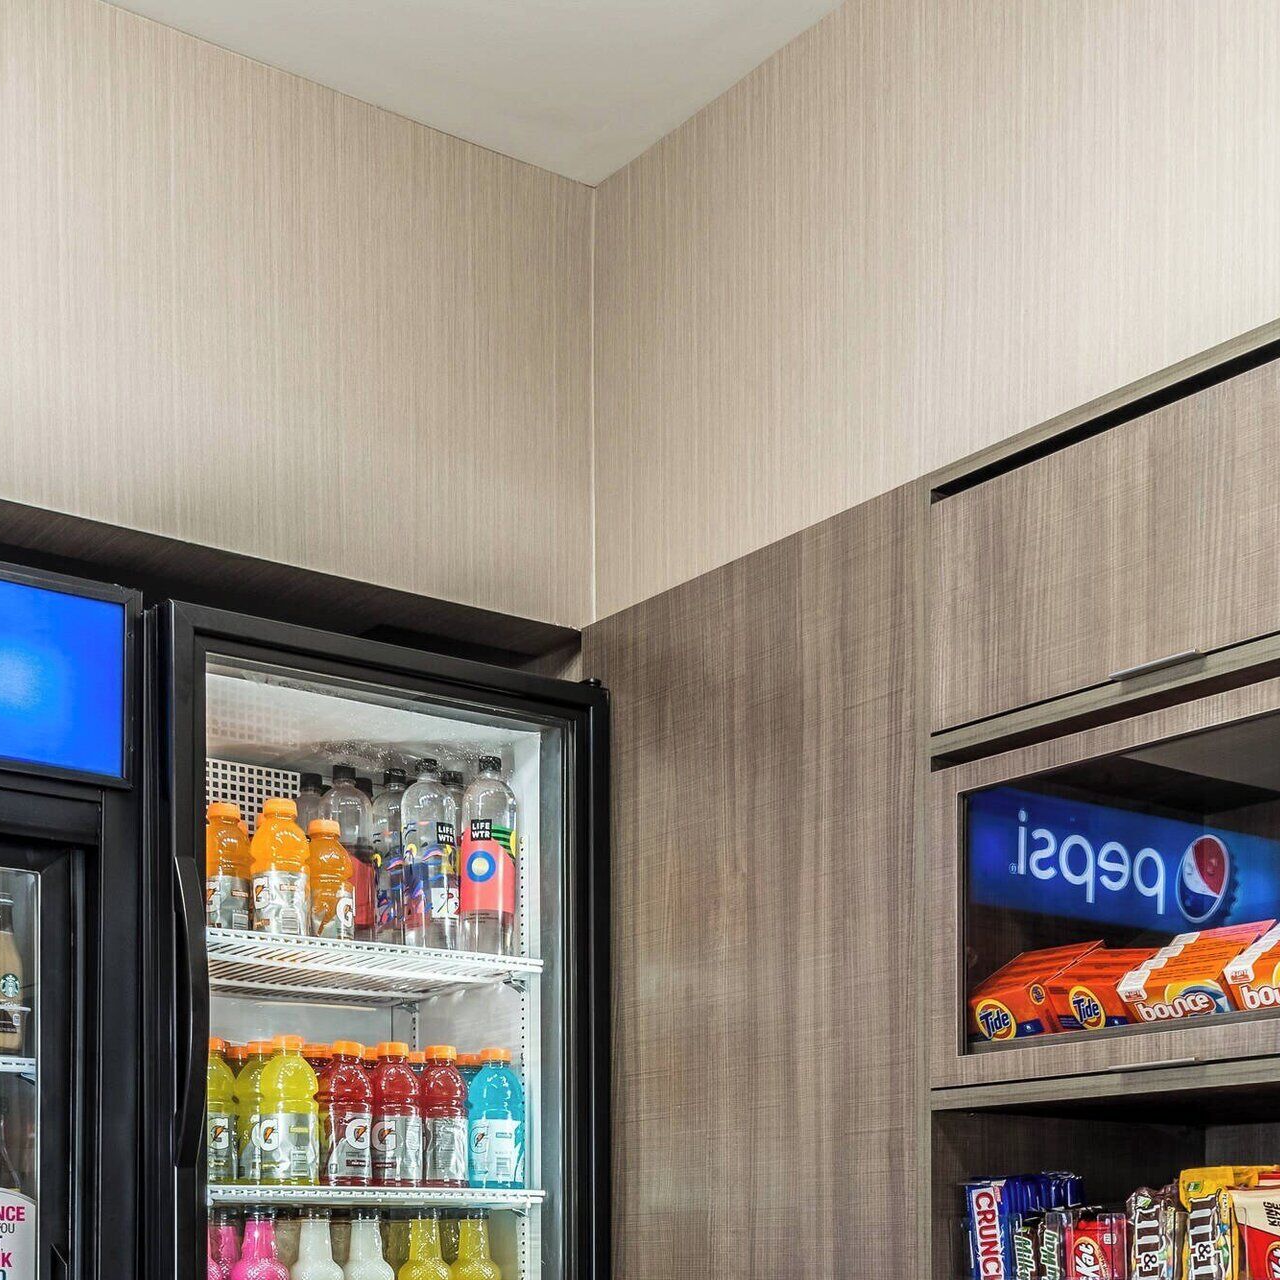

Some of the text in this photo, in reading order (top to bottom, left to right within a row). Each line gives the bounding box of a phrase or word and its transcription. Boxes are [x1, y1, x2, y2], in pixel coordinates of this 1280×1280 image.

[471, 821, 491, 831] LIFE
[471, 831, 492, 841] WTR
[1072, 996, 1102, 1022] Tide
[1136, 991, 1210, 1022] bounce
[979, 1007, 1014, 1038] Tide
[1262, 1201, 1277, 1228] KING
[1075, 1242, 1101, 1280] Kat
